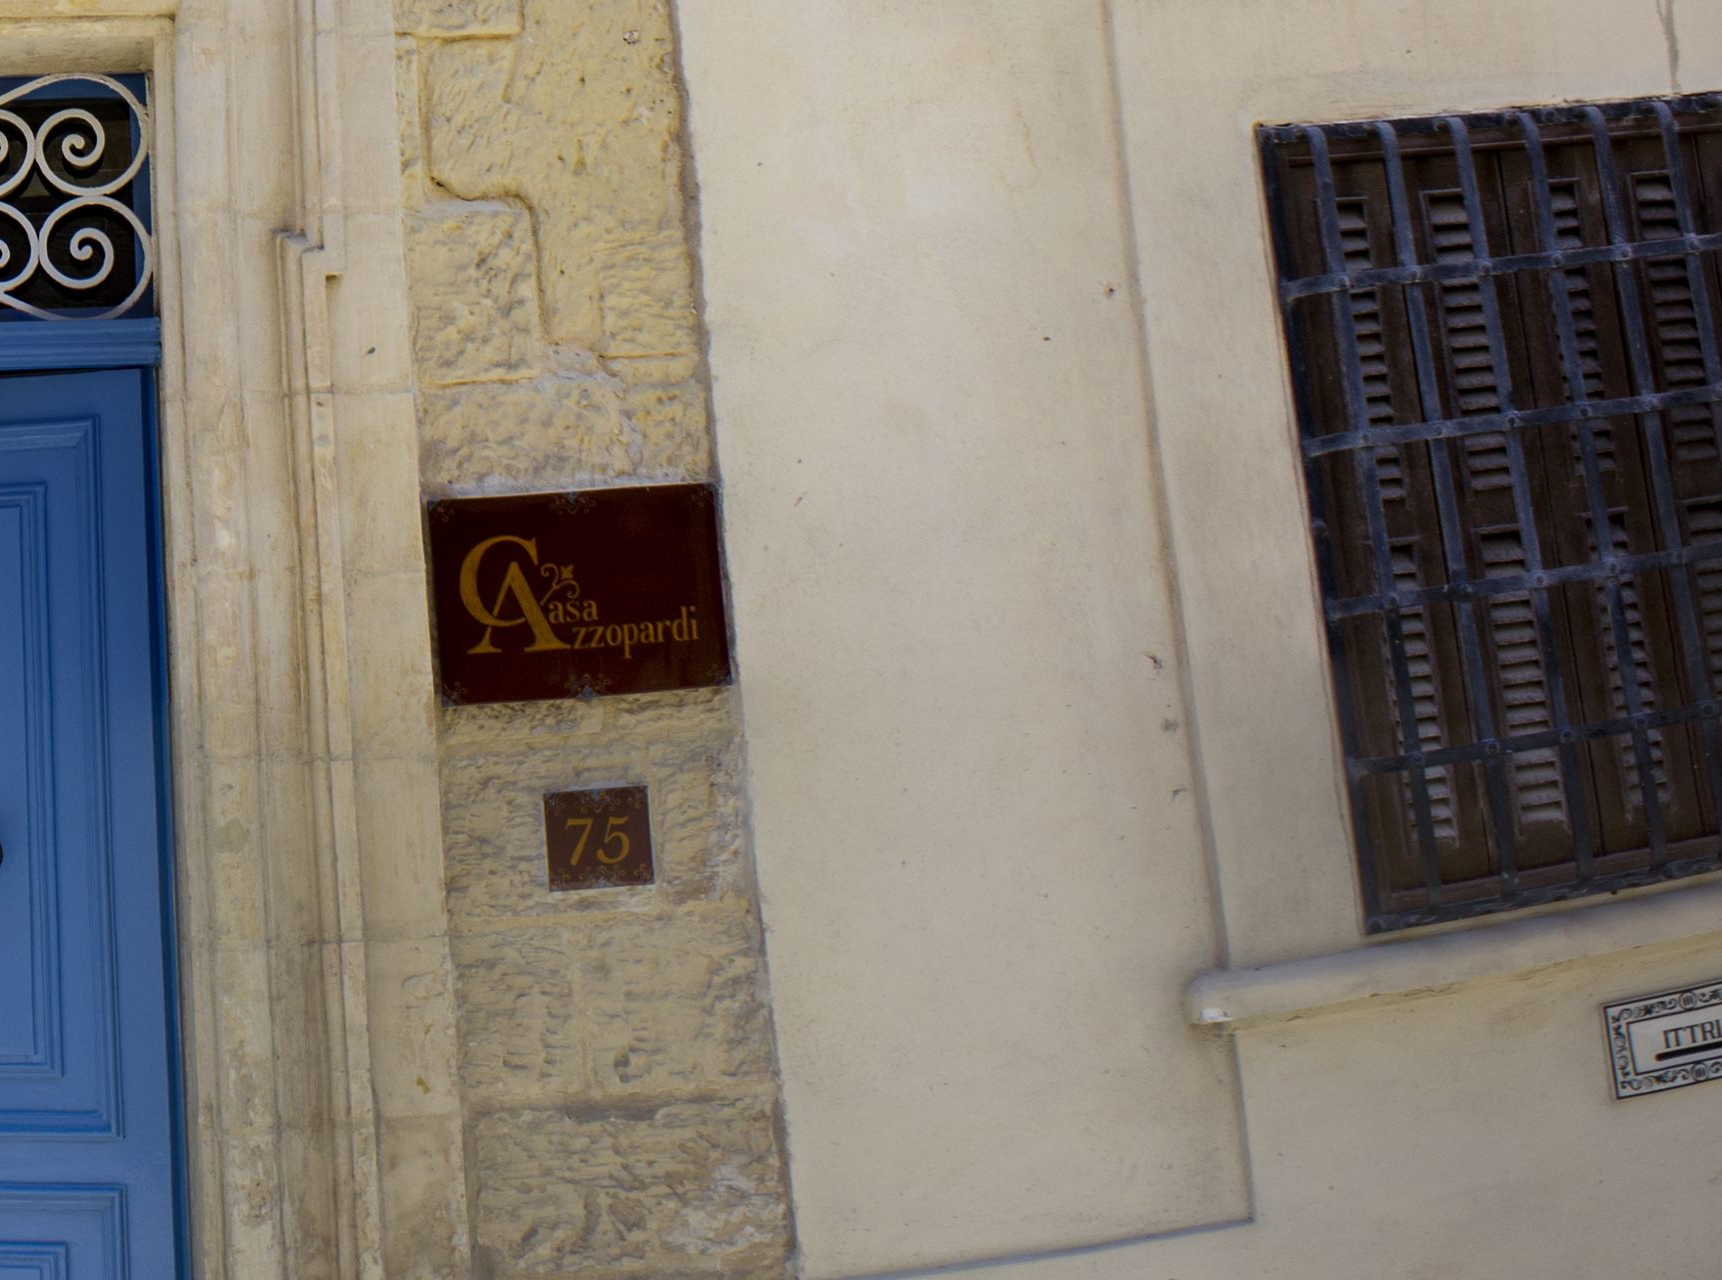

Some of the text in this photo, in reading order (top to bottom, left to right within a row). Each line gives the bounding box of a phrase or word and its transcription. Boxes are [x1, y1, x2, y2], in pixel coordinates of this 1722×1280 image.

[459, 534, 598, 626] Casa
[467, 561, 699, 659] Azzopardi
[565, 816, 630, 866] 75
